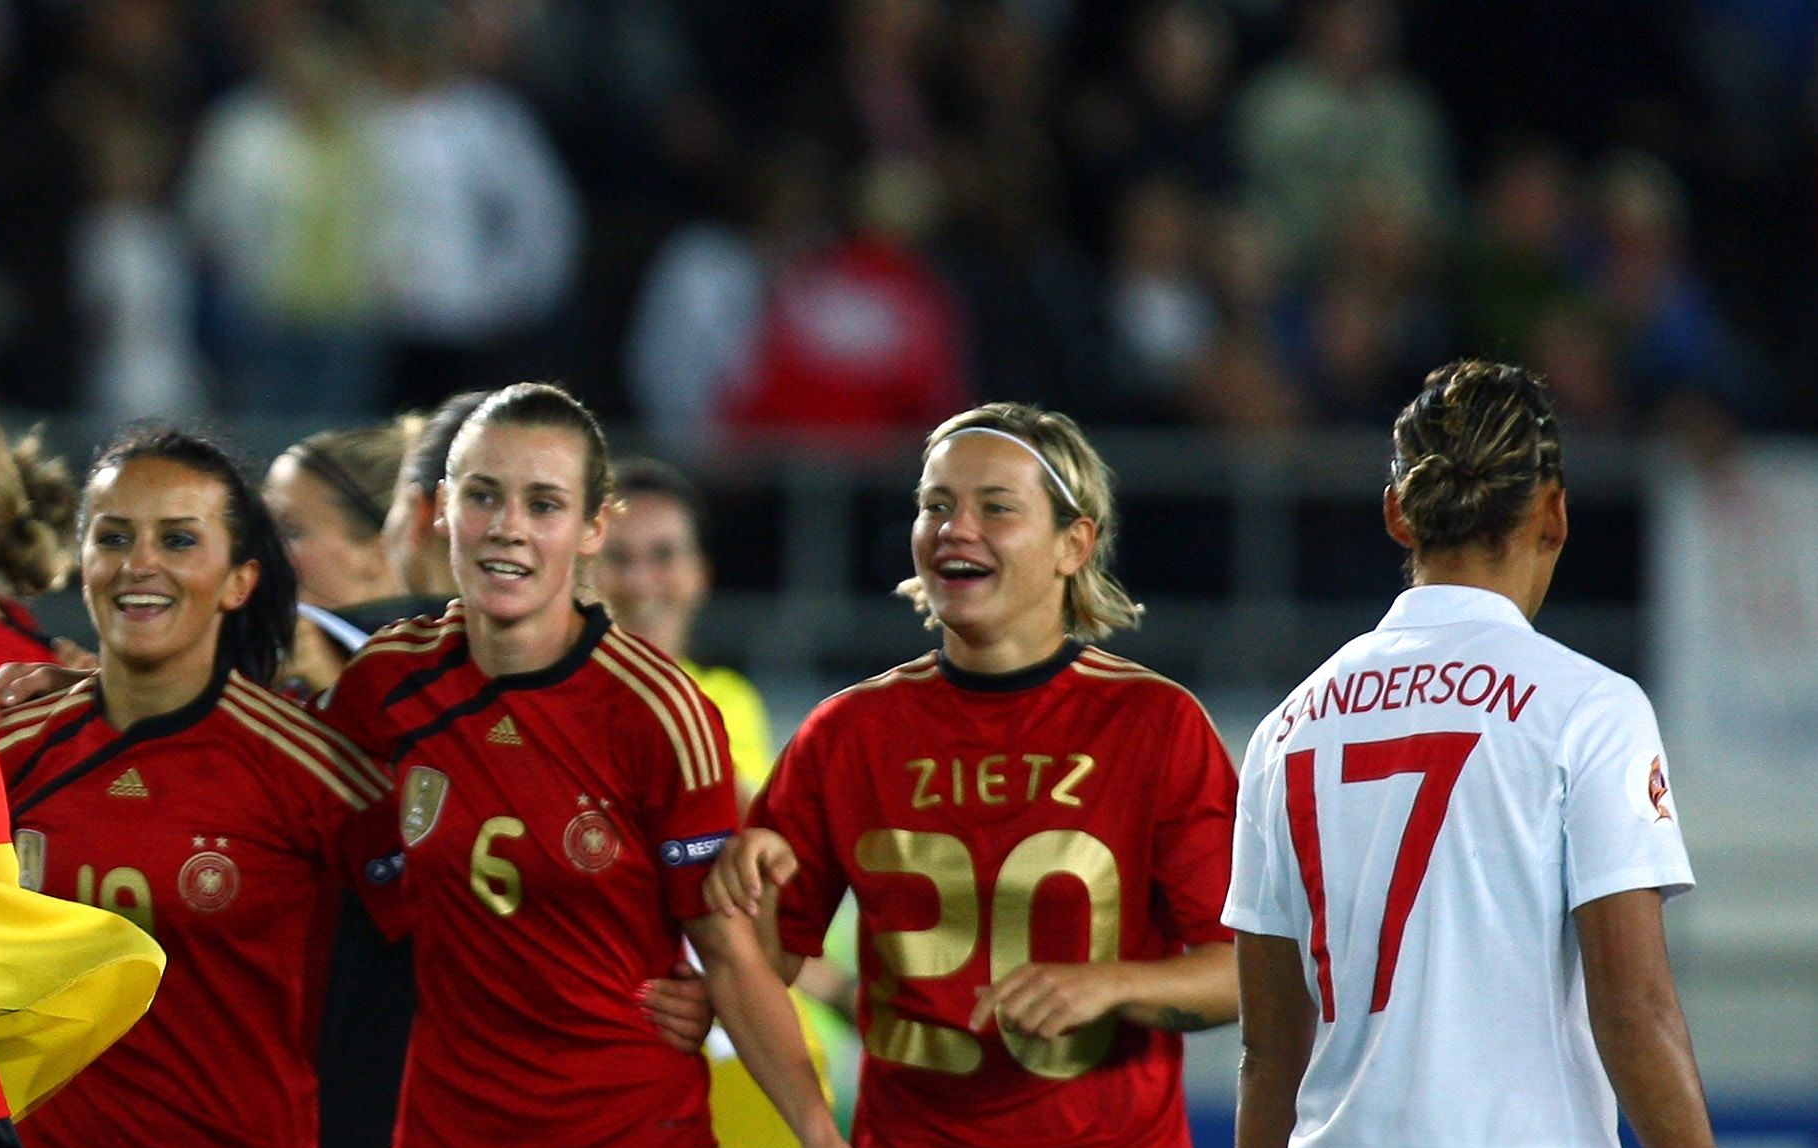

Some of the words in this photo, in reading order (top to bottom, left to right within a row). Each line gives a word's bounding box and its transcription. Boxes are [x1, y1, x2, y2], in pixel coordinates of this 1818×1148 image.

[1277, 662, 1537, 742] SANDERSON
[904, 753, 1094, 809] ZIETZ
[471, 815, 525, 915] 6
[1285, 731, 1482, 1022] 17
[856, 829, 1121, 1079] 20
